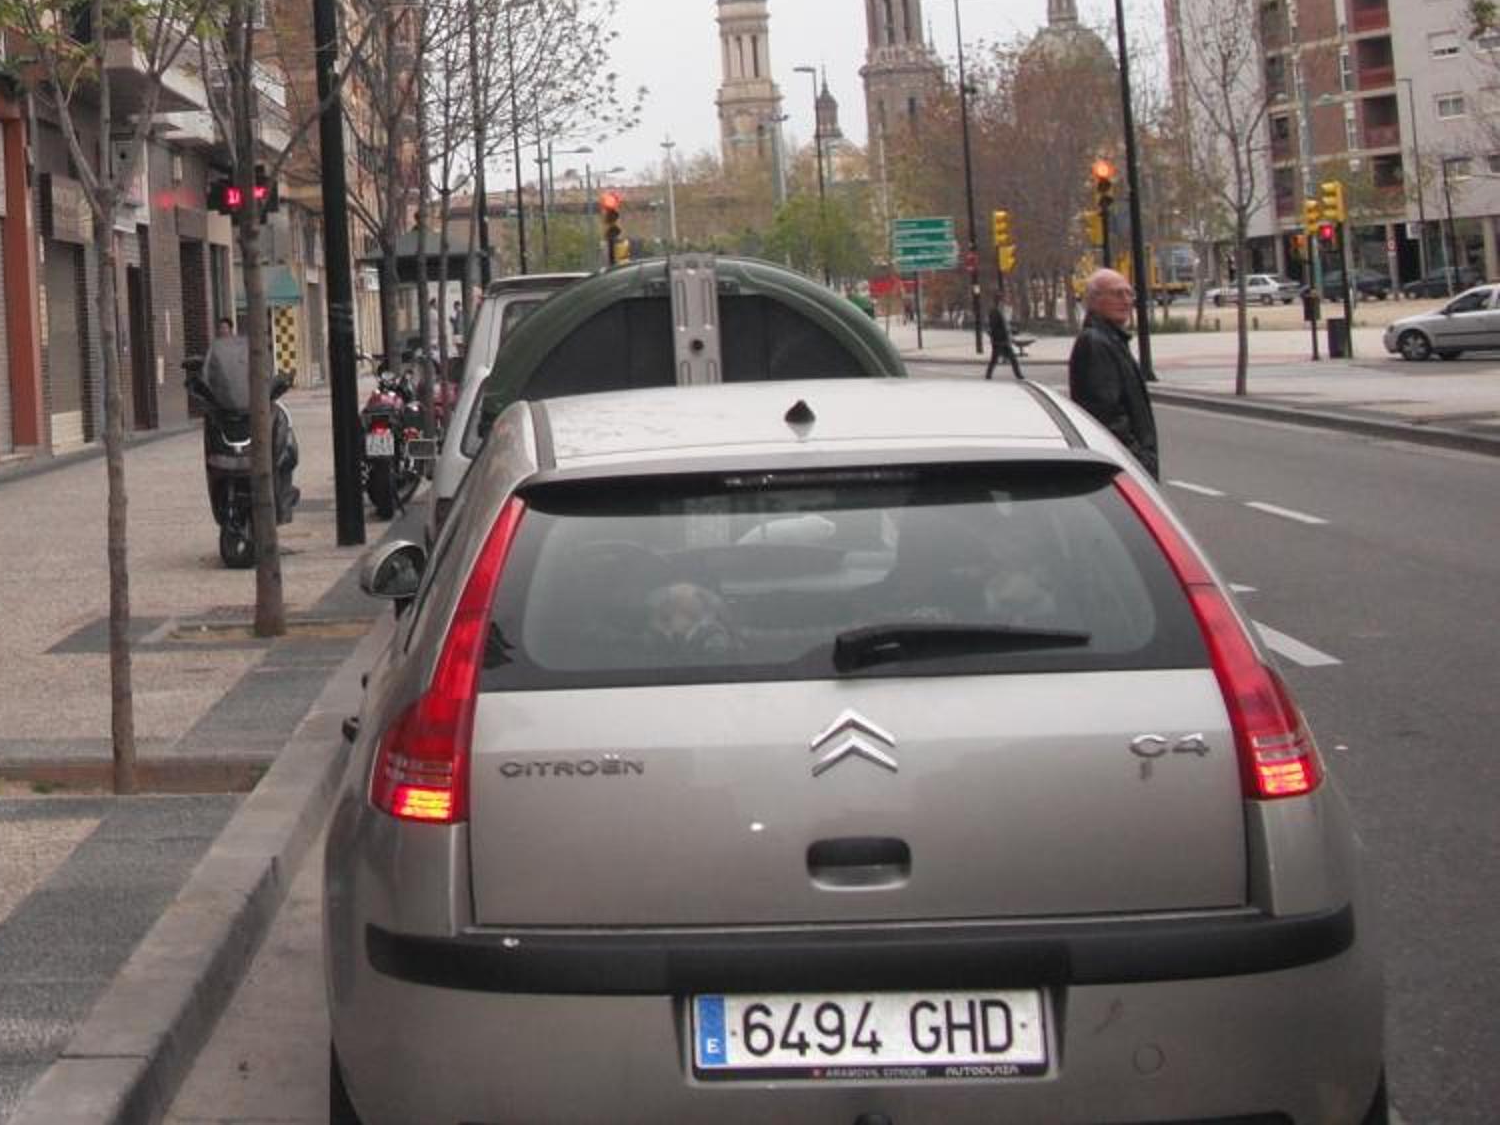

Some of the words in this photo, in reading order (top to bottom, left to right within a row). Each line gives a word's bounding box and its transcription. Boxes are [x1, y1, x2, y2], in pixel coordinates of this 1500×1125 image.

[1130, 732, 1210, 758] C4
[499, 754, 645, 777] CITROËN
[743, 1002, 883, 1057] 6494
[909, 999, 1013, 1055] GHD
[706, 1038, 720, 1054] E
